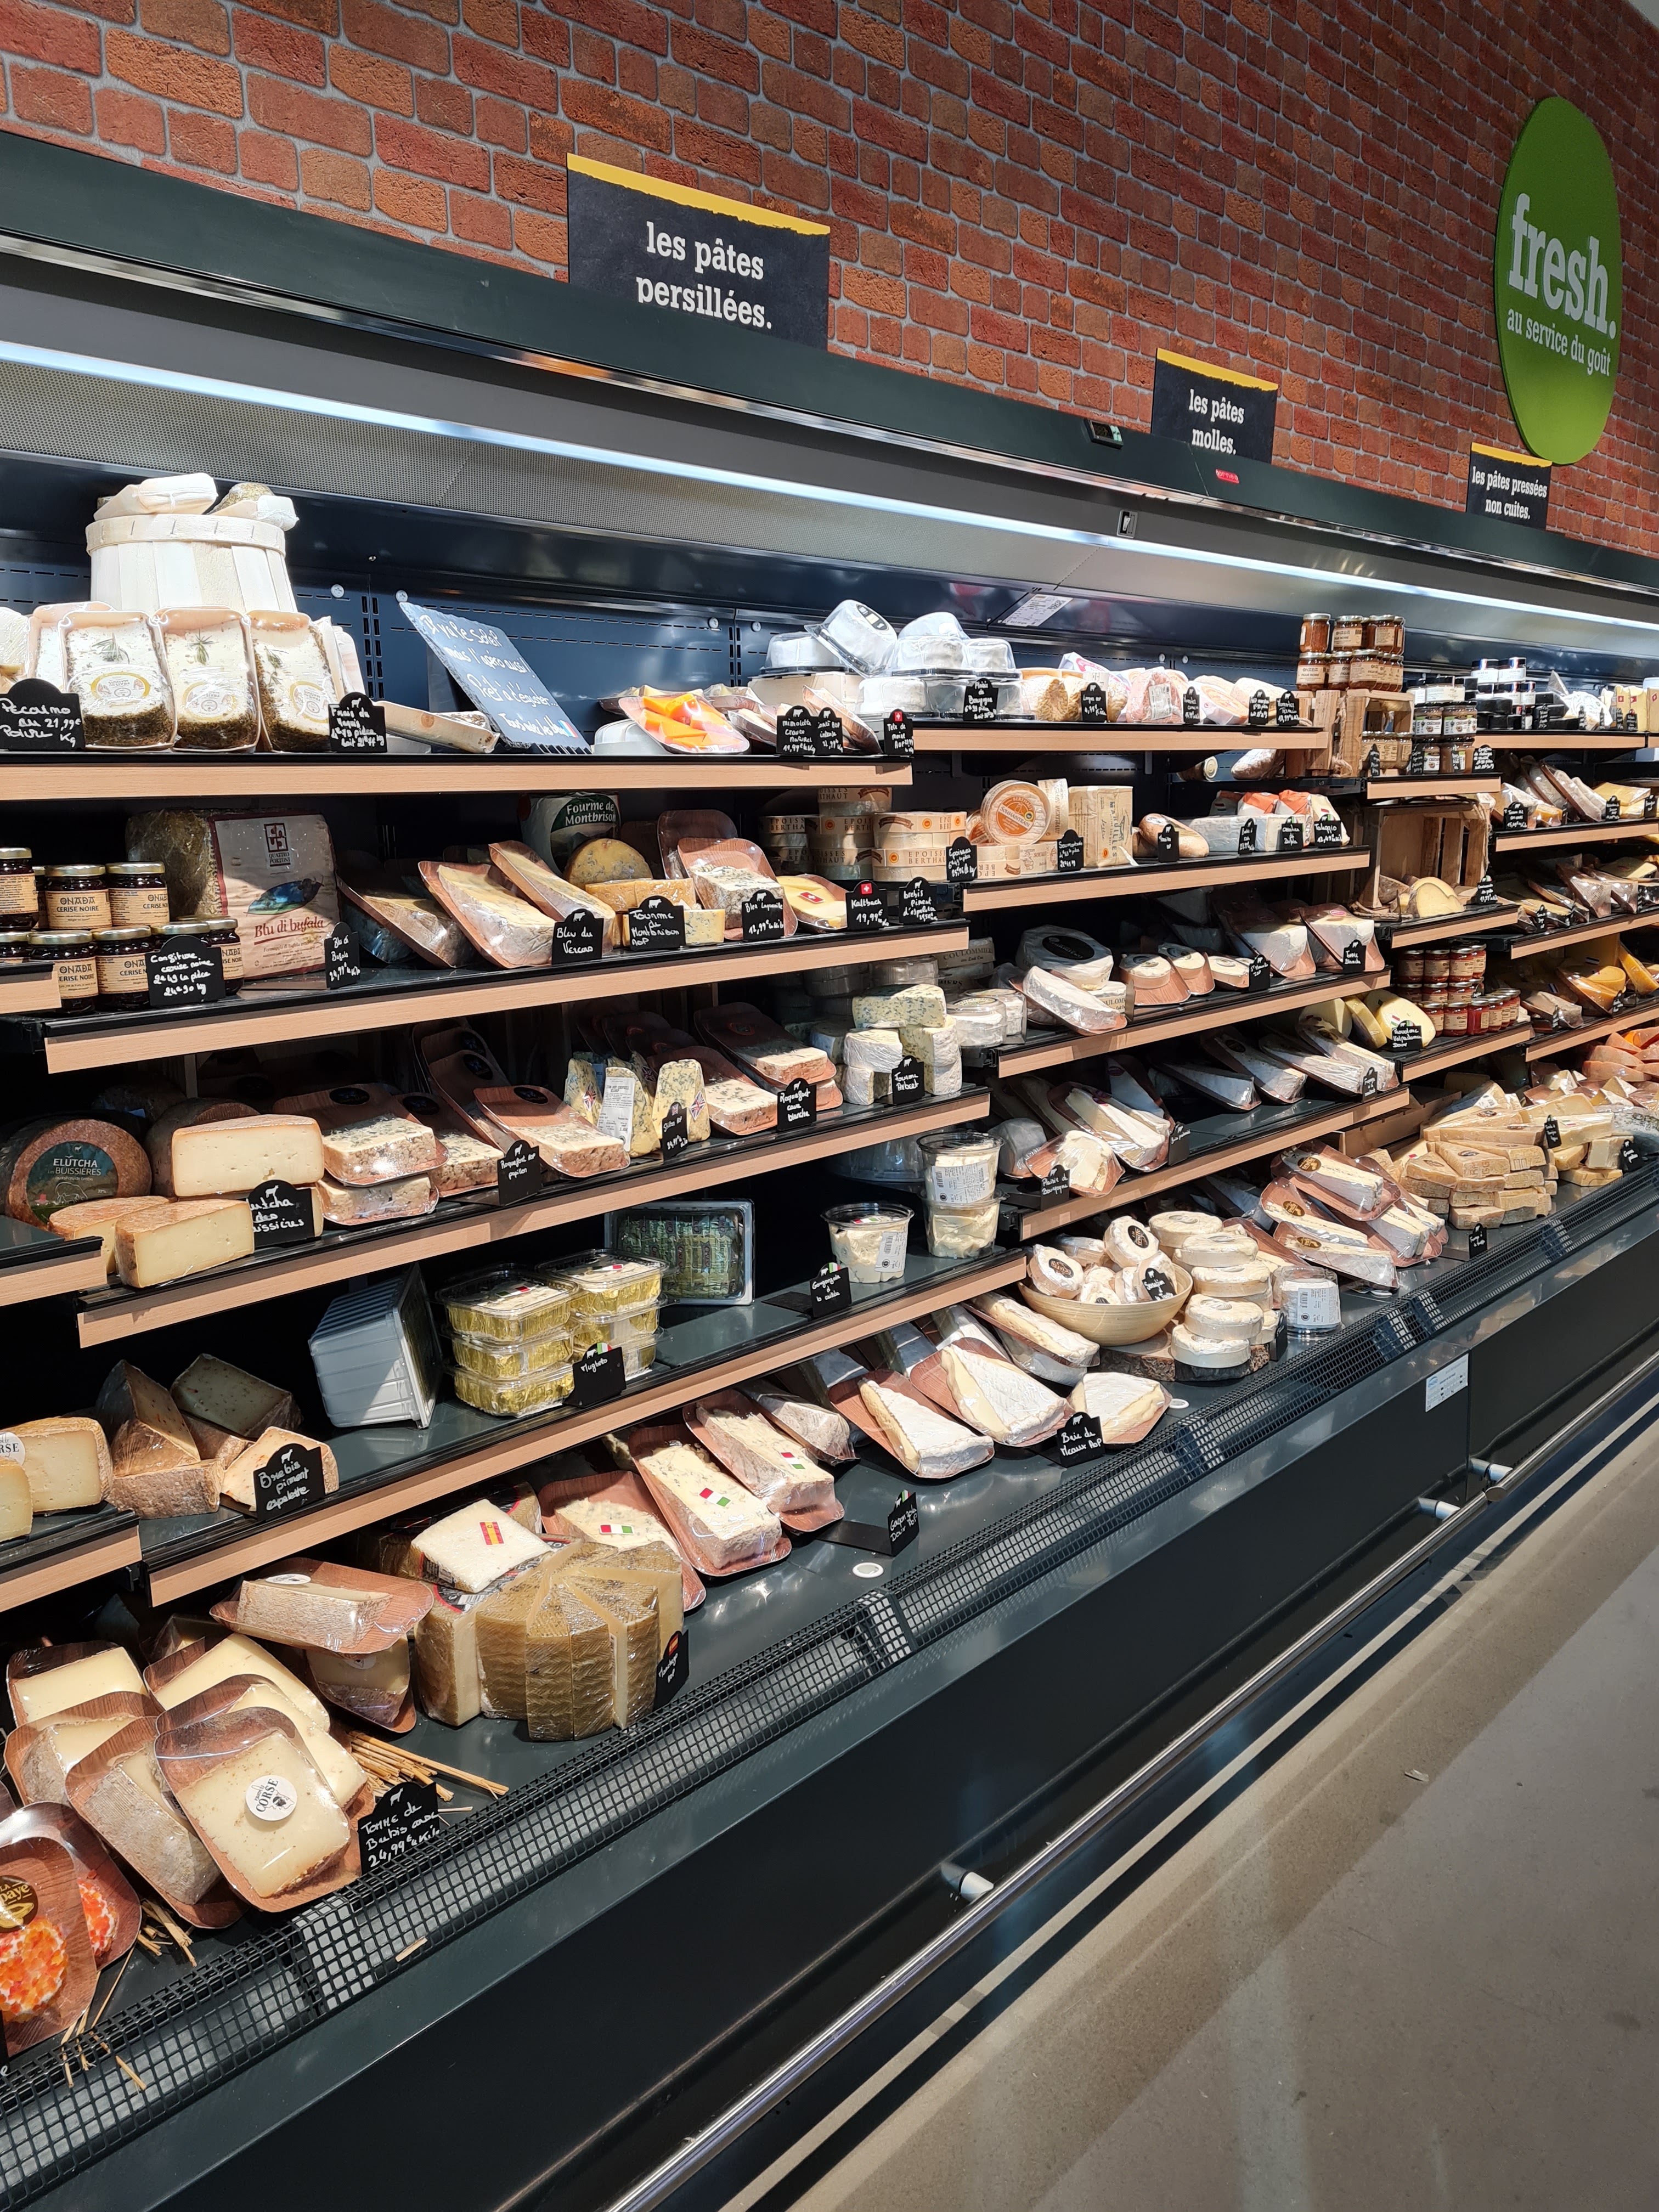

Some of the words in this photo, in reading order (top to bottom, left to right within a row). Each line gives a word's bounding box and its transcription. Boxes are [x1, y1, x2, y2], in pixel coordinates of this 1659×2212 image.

[646, 221, 686, 261] les
[695, 238, 764, 280] pâtes
[1508, 193, 1616, 340] fresh.
[636, 276, 772, 329] persillées.
[1507, 308, 1522, 335] au
[1526, 318, 1568, 356] service
[1571, 335, 1584, 364] du
[1587, 347, 1611, 376] goût
[1188, 388, 1208, 414] les
[1210, 397, 1244, 424] pâtes
[1192, 428, 1236, 455] molles.
[1472, 466, 1485, 486] les
[1486, 470, 1510, 491] pâtes
[1511, 479, 1548, 498] pressées
[1485, 499, 1502, 514] non
[1504, 500, 1531, 520] cuites.
[565, 811, 616, 826] Montbrison
[566, 802, 603, 815] Fourme
[606, 801, 614, 811] de
[851, 898, 882, 909] Kaltbach
[254, 924, 274, 938] Blu
[277, 919, 287, 932] di
[290, 916, 324, 933] bufala
[556, 927, 577, 938] Bleu
[581, 926, 593, 938] du
[648, 920, 661, 928] de
[246, 1196, 294, 1211] utcha
[1062, 1432, 1082, 1443] Brie
[1085, 1427, 1096, 1437] de
[1088, 1438, 1102, 1448] AOP
[0, 1443, 19, 1454] RSE
[258, 1460, 301, 1488] Brebis
[256, 1779, 279, 1813] CORSE
[404, 1802, 422, 1817] de
